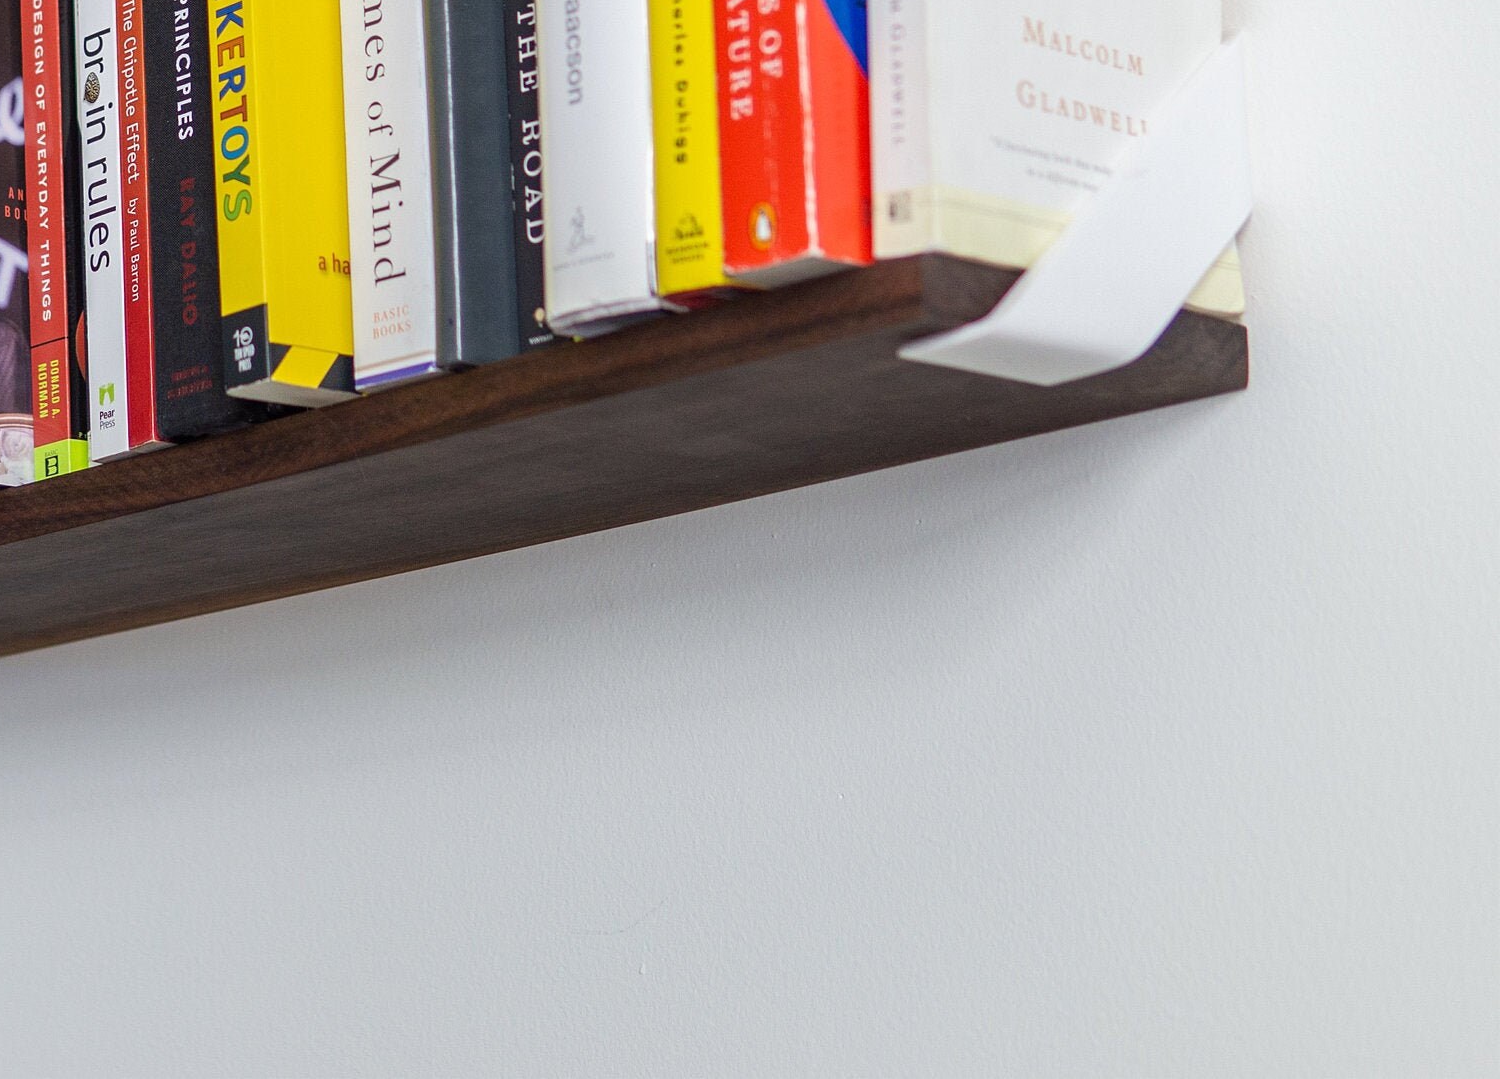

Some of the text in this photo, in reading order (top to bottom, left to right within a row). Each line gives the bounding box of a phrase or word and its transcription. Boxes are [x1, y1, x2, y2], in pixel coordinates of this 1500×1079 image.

[758, 26, 783, 81] OF
[1022, 15, 1145, 77] MALCOLM
[35, 84, 46, 111] OF
[120, 35, 138, 119] Chipotle
[366, 100, 393, 137] of
[516, 2, 546, 245] THE ROAD
[674, 80, 690, 165] Duhigg
[36, 121, 49, 229] EVERYDAY
[83, 27, 117, 273] brin rules
[125, 121, 140, 184] Effect
[8, 186, 24, 201] AN
[126, 198, 139, 216] by
[369, 148, 407, 287] Mind
[129, 219, 140, 256] Paul
[180, 175, 198, 327] RAY DALIO
[318, 256, 327, 271] a
[40, 239, 52, 322] THINGS
[130, 258, 140, 302] Barron
[372, 321, 412, 340] BOOKS
[373, 304, 409, 324] BASIC
[38, 363, 49, 419] NORMAN
[50, 358, 60, 419] DONALD A.
[99, 408, 115, 421] Pear
[99, 418, 116, 430] Press
